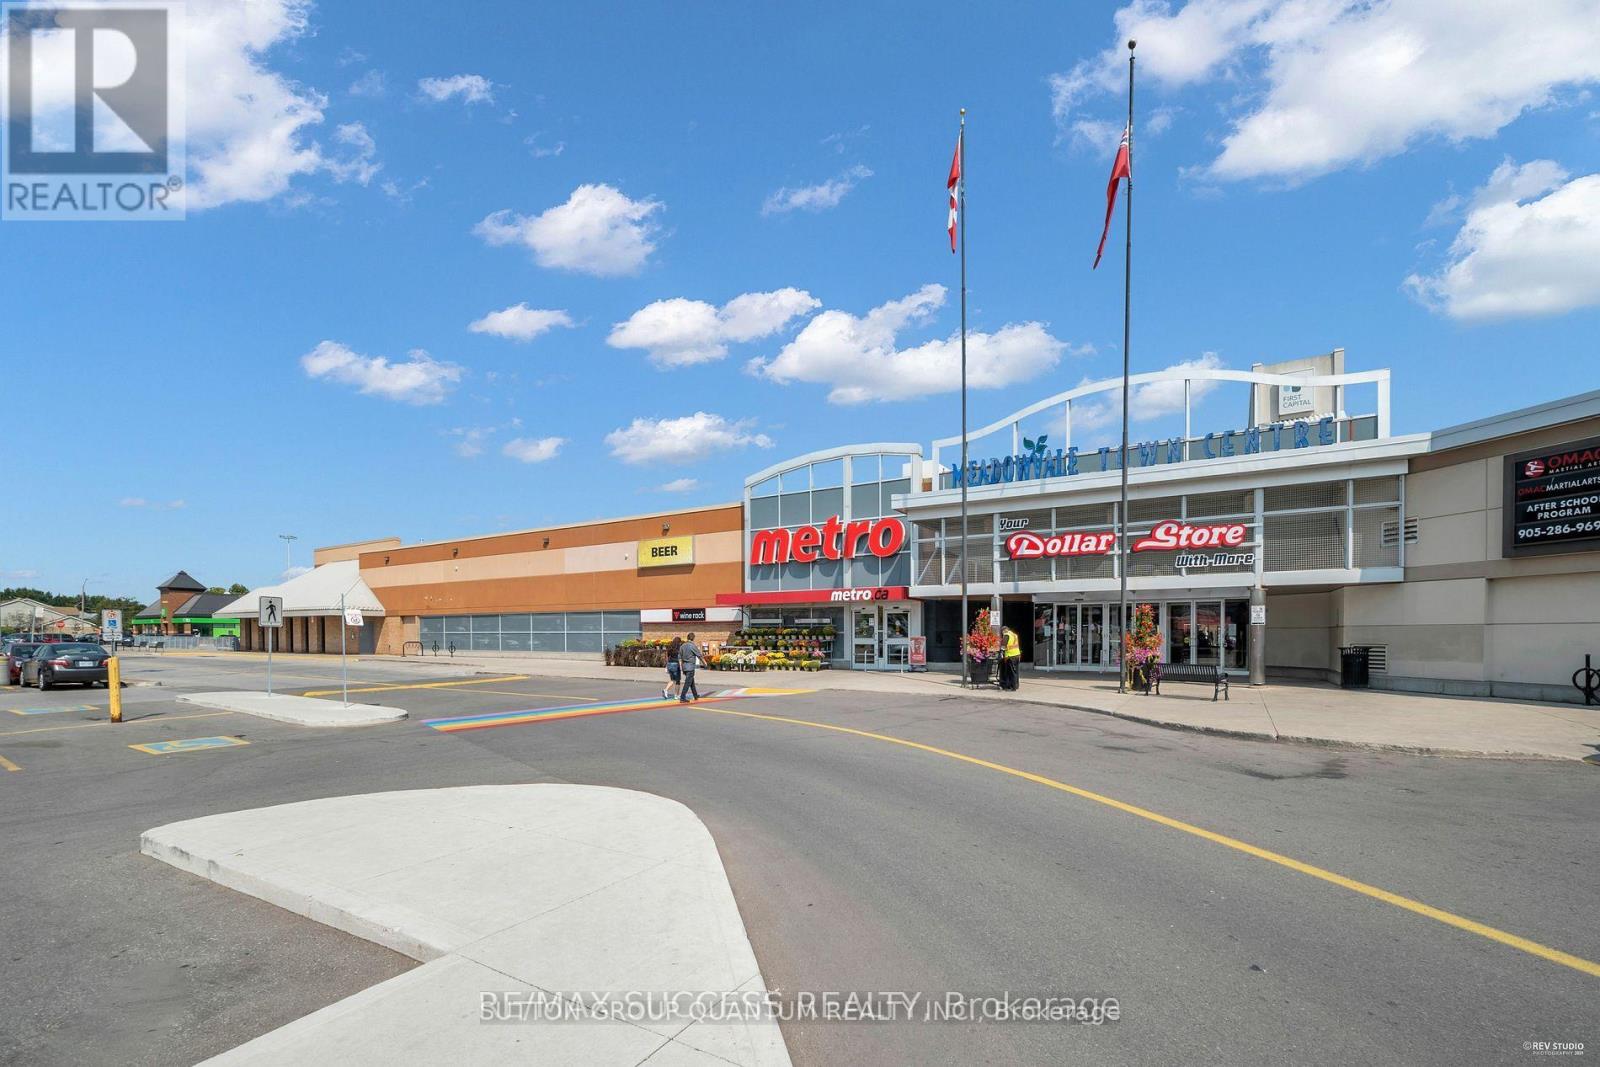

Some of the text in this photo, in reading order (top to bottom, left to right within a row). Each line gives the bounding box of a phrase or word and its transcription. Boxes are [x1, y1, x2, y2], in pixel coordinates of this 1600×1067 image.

[1282, 399, 1312, 409] CAPITAL
[1283, 394, 1302, 402] FIRST
[952, 416, 1334, 490] MEADOWVALE TOWN CENTRE
[1549, 464, 1583, 474] MARTIAL
[1526, 501, 1557, 513] AFTER
[1537, 506, 1591, 520] PROGRAM
[1000, 518, 1029, 530] Your
[751, 515, 906, 566] metro
[1008, 521, 1245, 557] Dollar Store
[651, 545, 678, 558] BEER
[830, 587, 889, 602] metro.ca
[680, 611, 692, 619] wine
